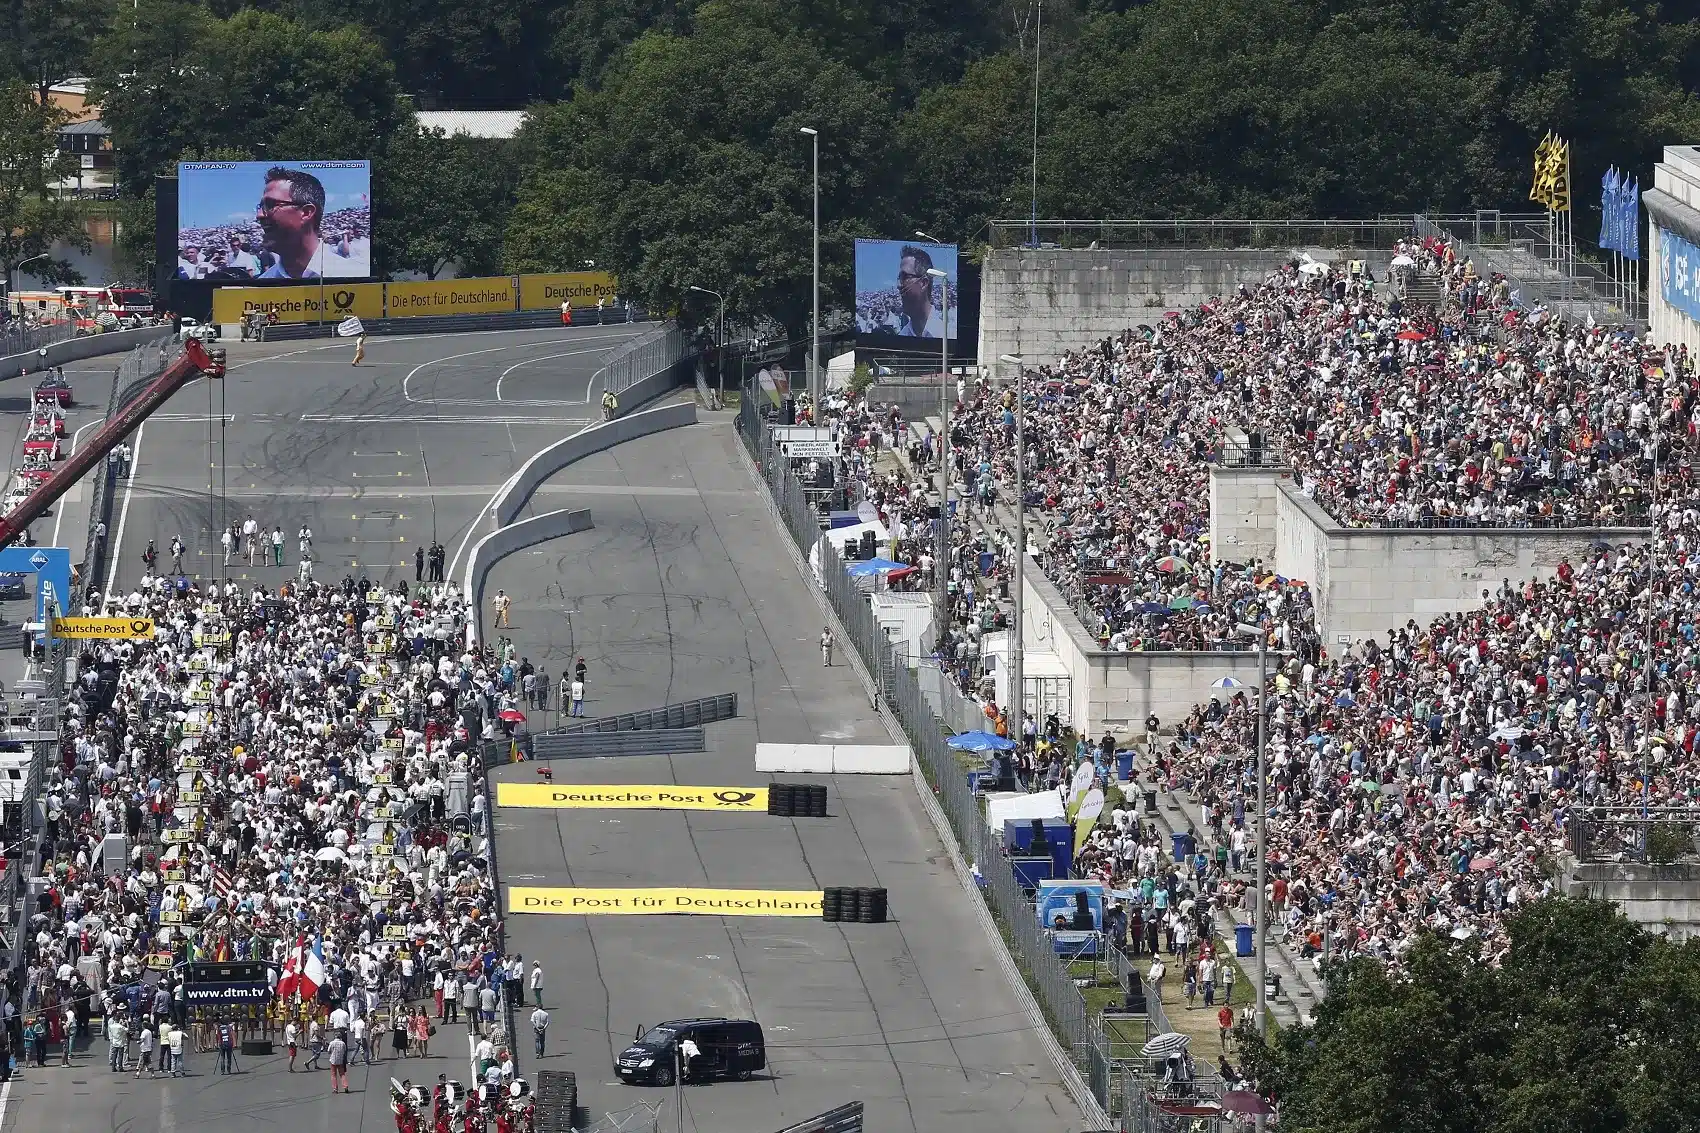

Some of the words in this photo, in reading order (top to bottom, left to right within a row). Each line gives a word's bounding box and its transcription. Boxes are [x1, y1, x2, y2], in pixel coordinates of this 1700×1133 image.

[392, 295, 408, 308] Die
[410, 293, 431, 306] Post
[434, 292, 448, 304] für
[450, 288, 510, 304] Deutschland.
[544, 284, 592, 298] Deutsche
[594, 284, 616, 296] Post
[244, 299, 301, 312] Deutsche
[304, 298, 328, 311] Post
[55, 623, 101, 634] Deutsche
[104, 623, 126, 634] Post
[552, 792, 653, 802] Deutsche
[658, 793, 704, 804] Post
[524, 896, 563, 906] Die
[573, 897, 620, 908] Post
[632, 896, 666, 907] für
[676, 896, 824, 910] Deutschland
[188, 988, 264, 998] www.dtm.tv
